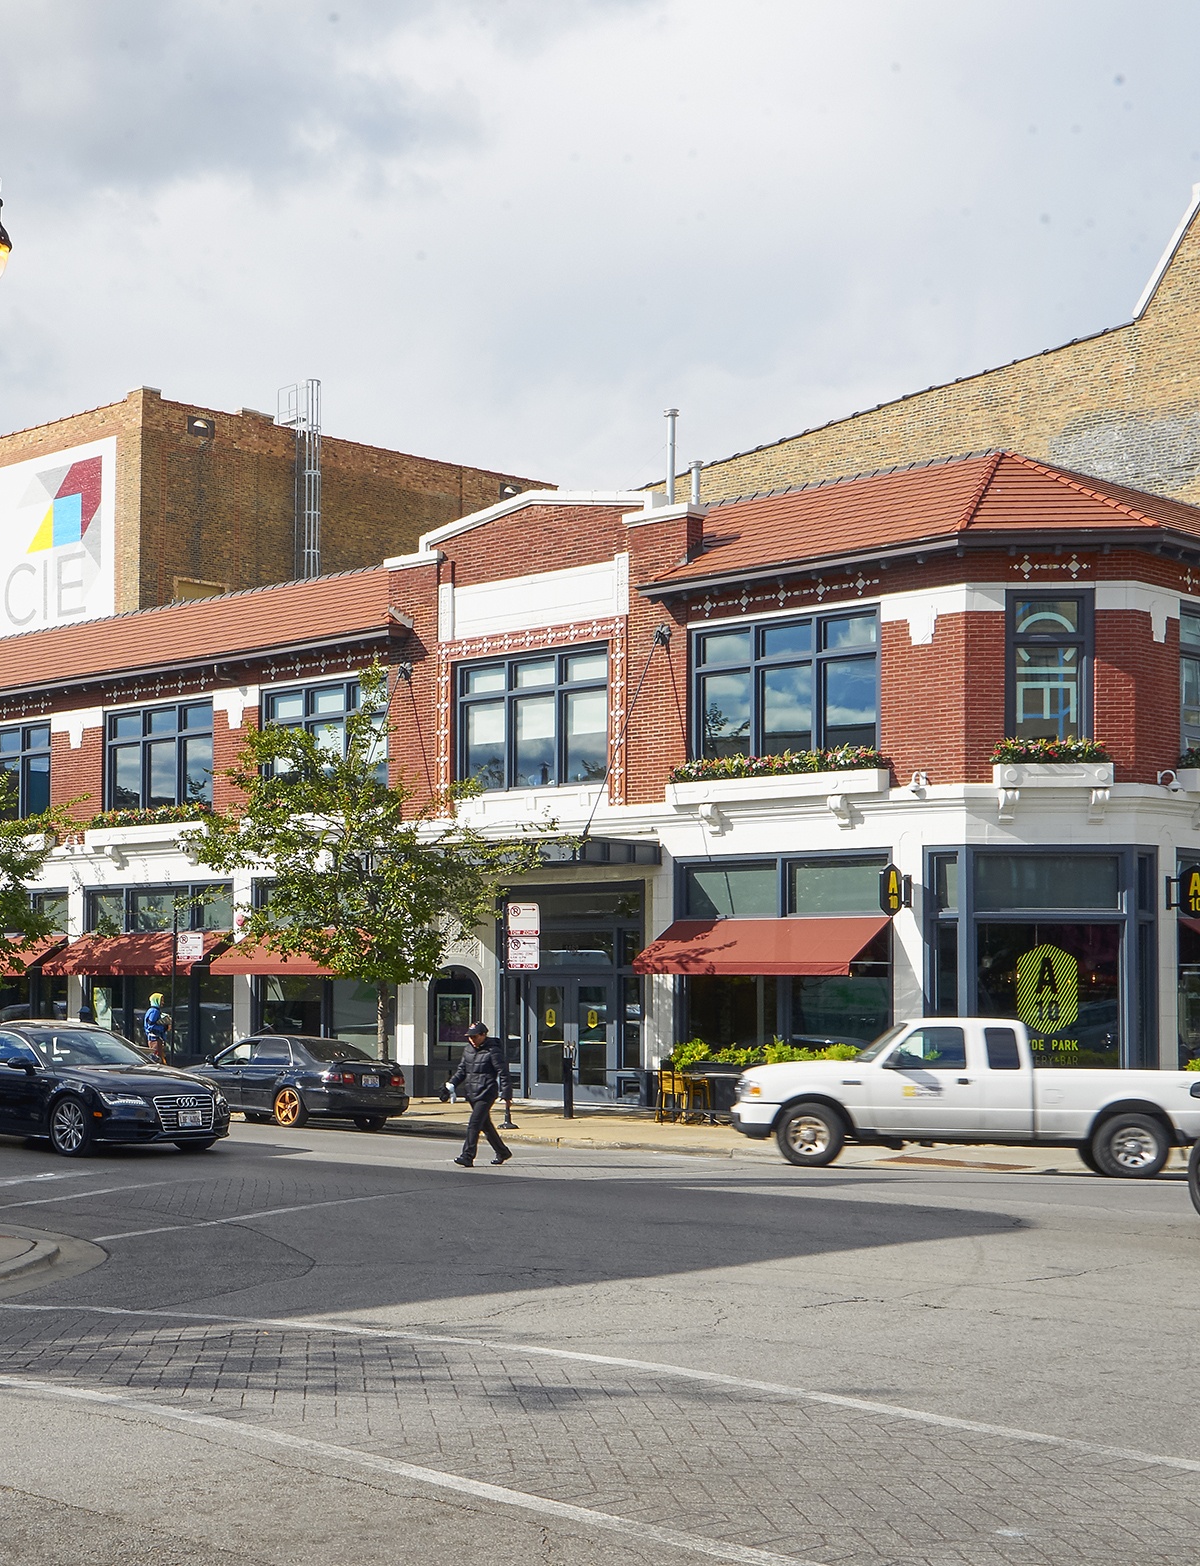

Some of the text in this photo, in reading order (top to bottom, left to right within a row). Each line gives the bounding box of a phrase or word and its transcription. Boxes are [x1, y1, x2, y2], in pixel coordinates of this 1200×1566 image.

[4, 550, 87, 627] CIE
[1036, 957, 1058, 995] A
[1028, 1039, 1079, 1052] DE PARK
[1060, 1055, 1079, 1066] BAR
